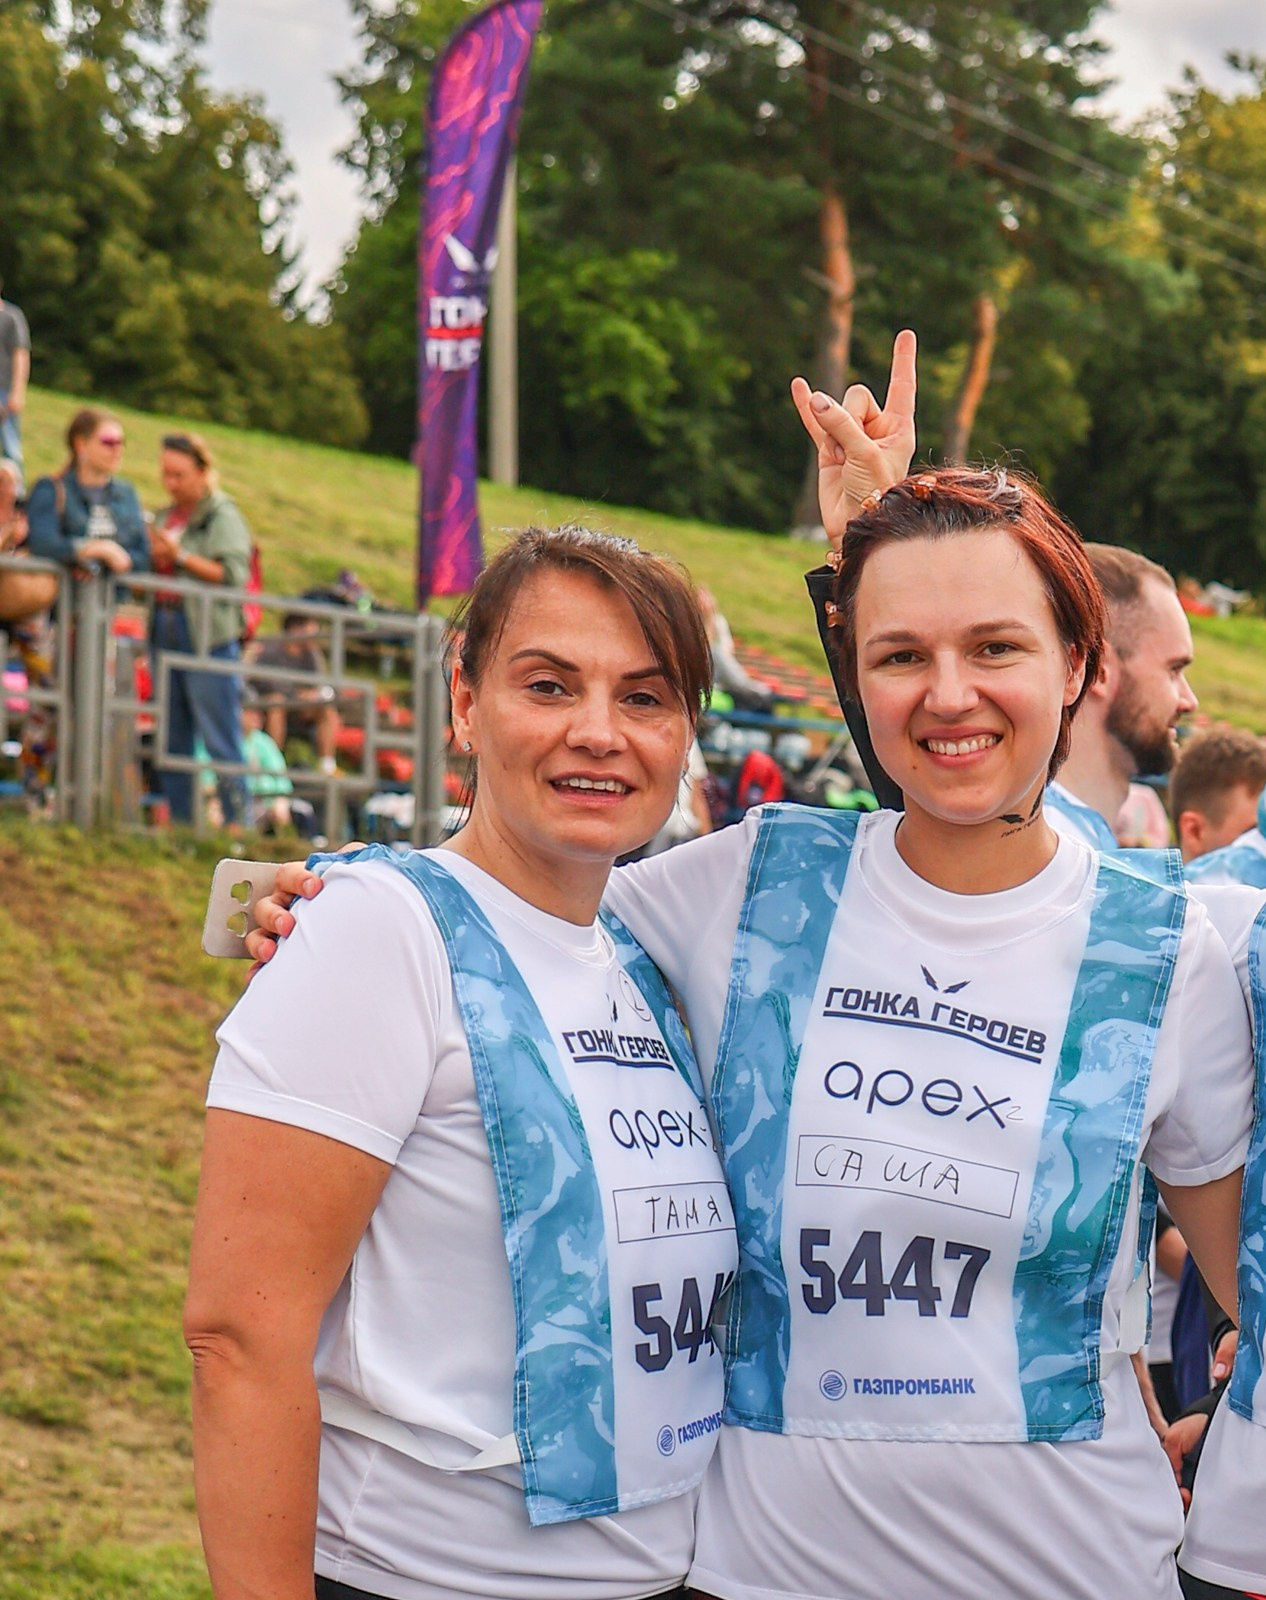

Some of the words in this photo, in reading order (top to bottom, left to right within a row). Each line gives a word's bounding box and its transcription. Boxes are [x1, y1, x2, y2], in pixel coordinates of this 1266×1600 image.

[824, 986, 921, 1019] ГОНКА
[930, 1002, 1047, 1054] ГЕРОЕВ
[617, 1034, 671, 1062] ГЕРОЕВ
[823, 1060, 1012, 1130] apex
[608, 1107, 708, 1160] apex
[799, 1227, 992, 1319] 5447
[853, 1377, 976, 1396] ГАЗПРОМБАНК
[677, 1410, 724, 1444] ГАЗПРОМБ
